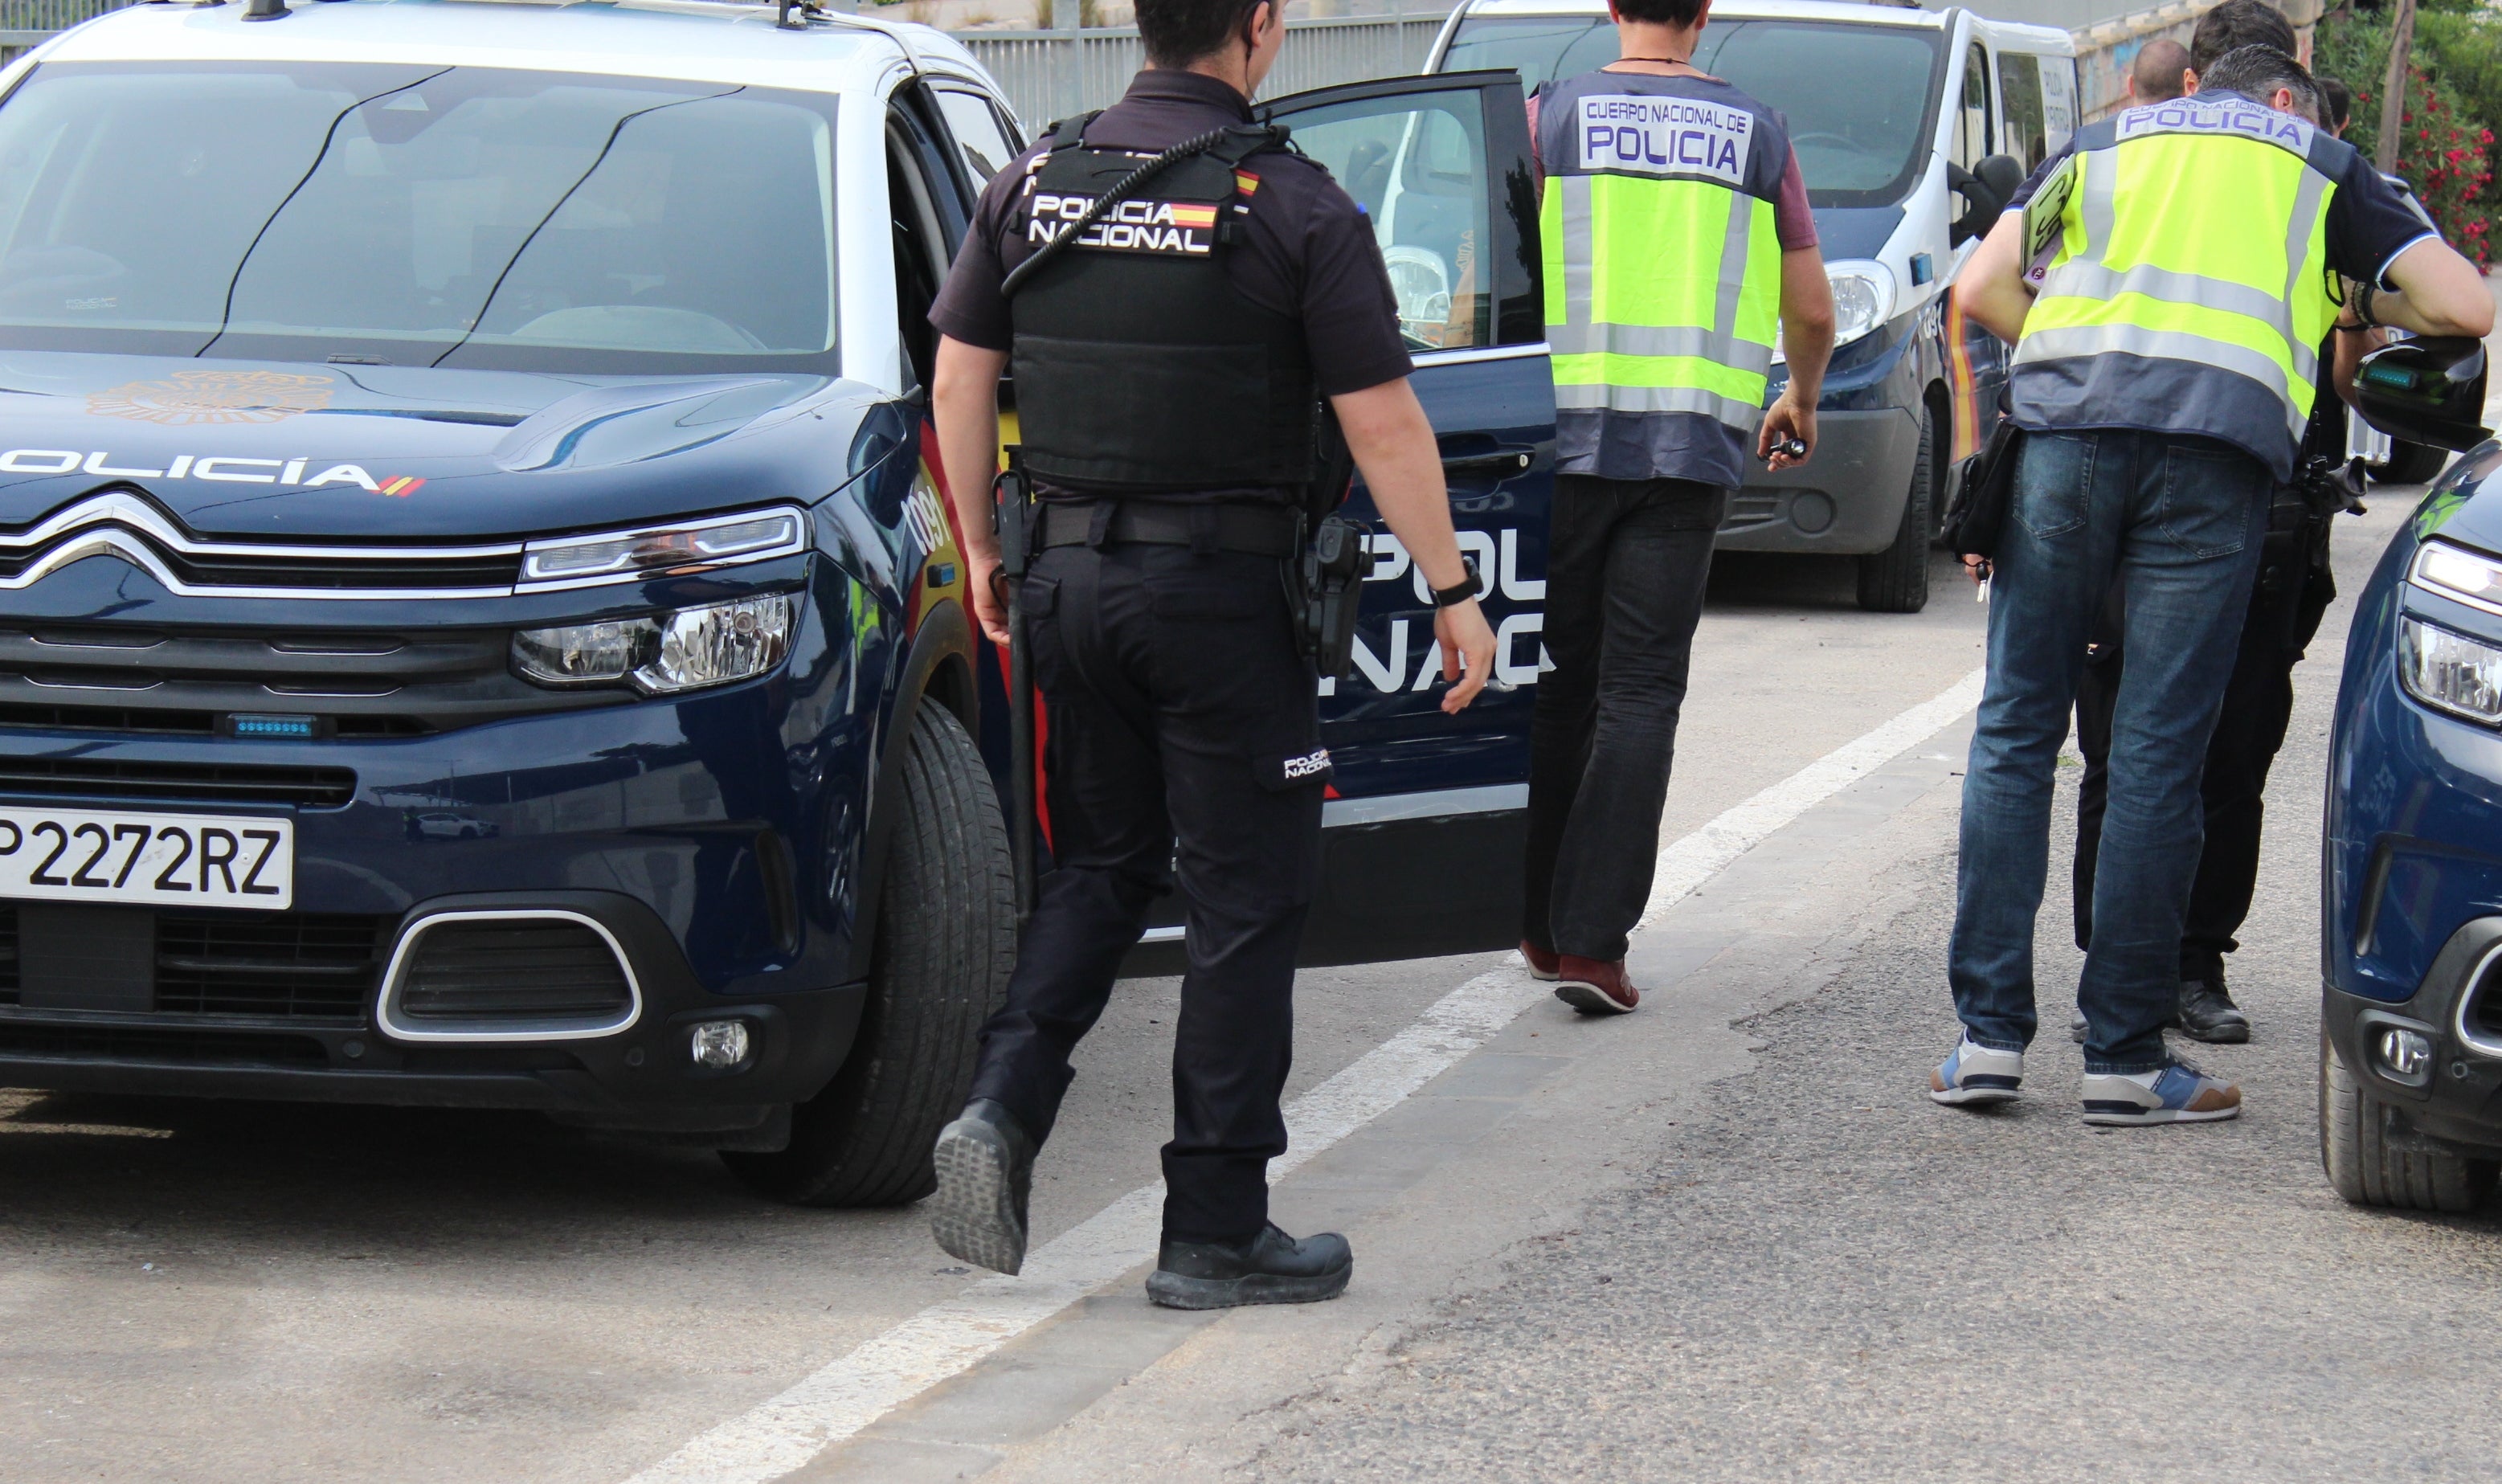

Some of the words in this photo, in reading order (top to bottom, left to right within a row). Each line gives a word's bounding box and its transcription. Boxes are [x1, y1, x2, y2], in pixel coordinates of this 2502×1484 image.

[1587, 102, 1647, 121] CUERPO
[1651, 104, 1723, 129] NACIONAL
[1727, 113, 1747, 134] DE
[2130, 100, 2197, 113] CUPO
[2125, 108, 2301, 147] POLICIA
[1587, 125, 1737, 174] POLICIA
[0, 820, 280, 894] P2272RZ
